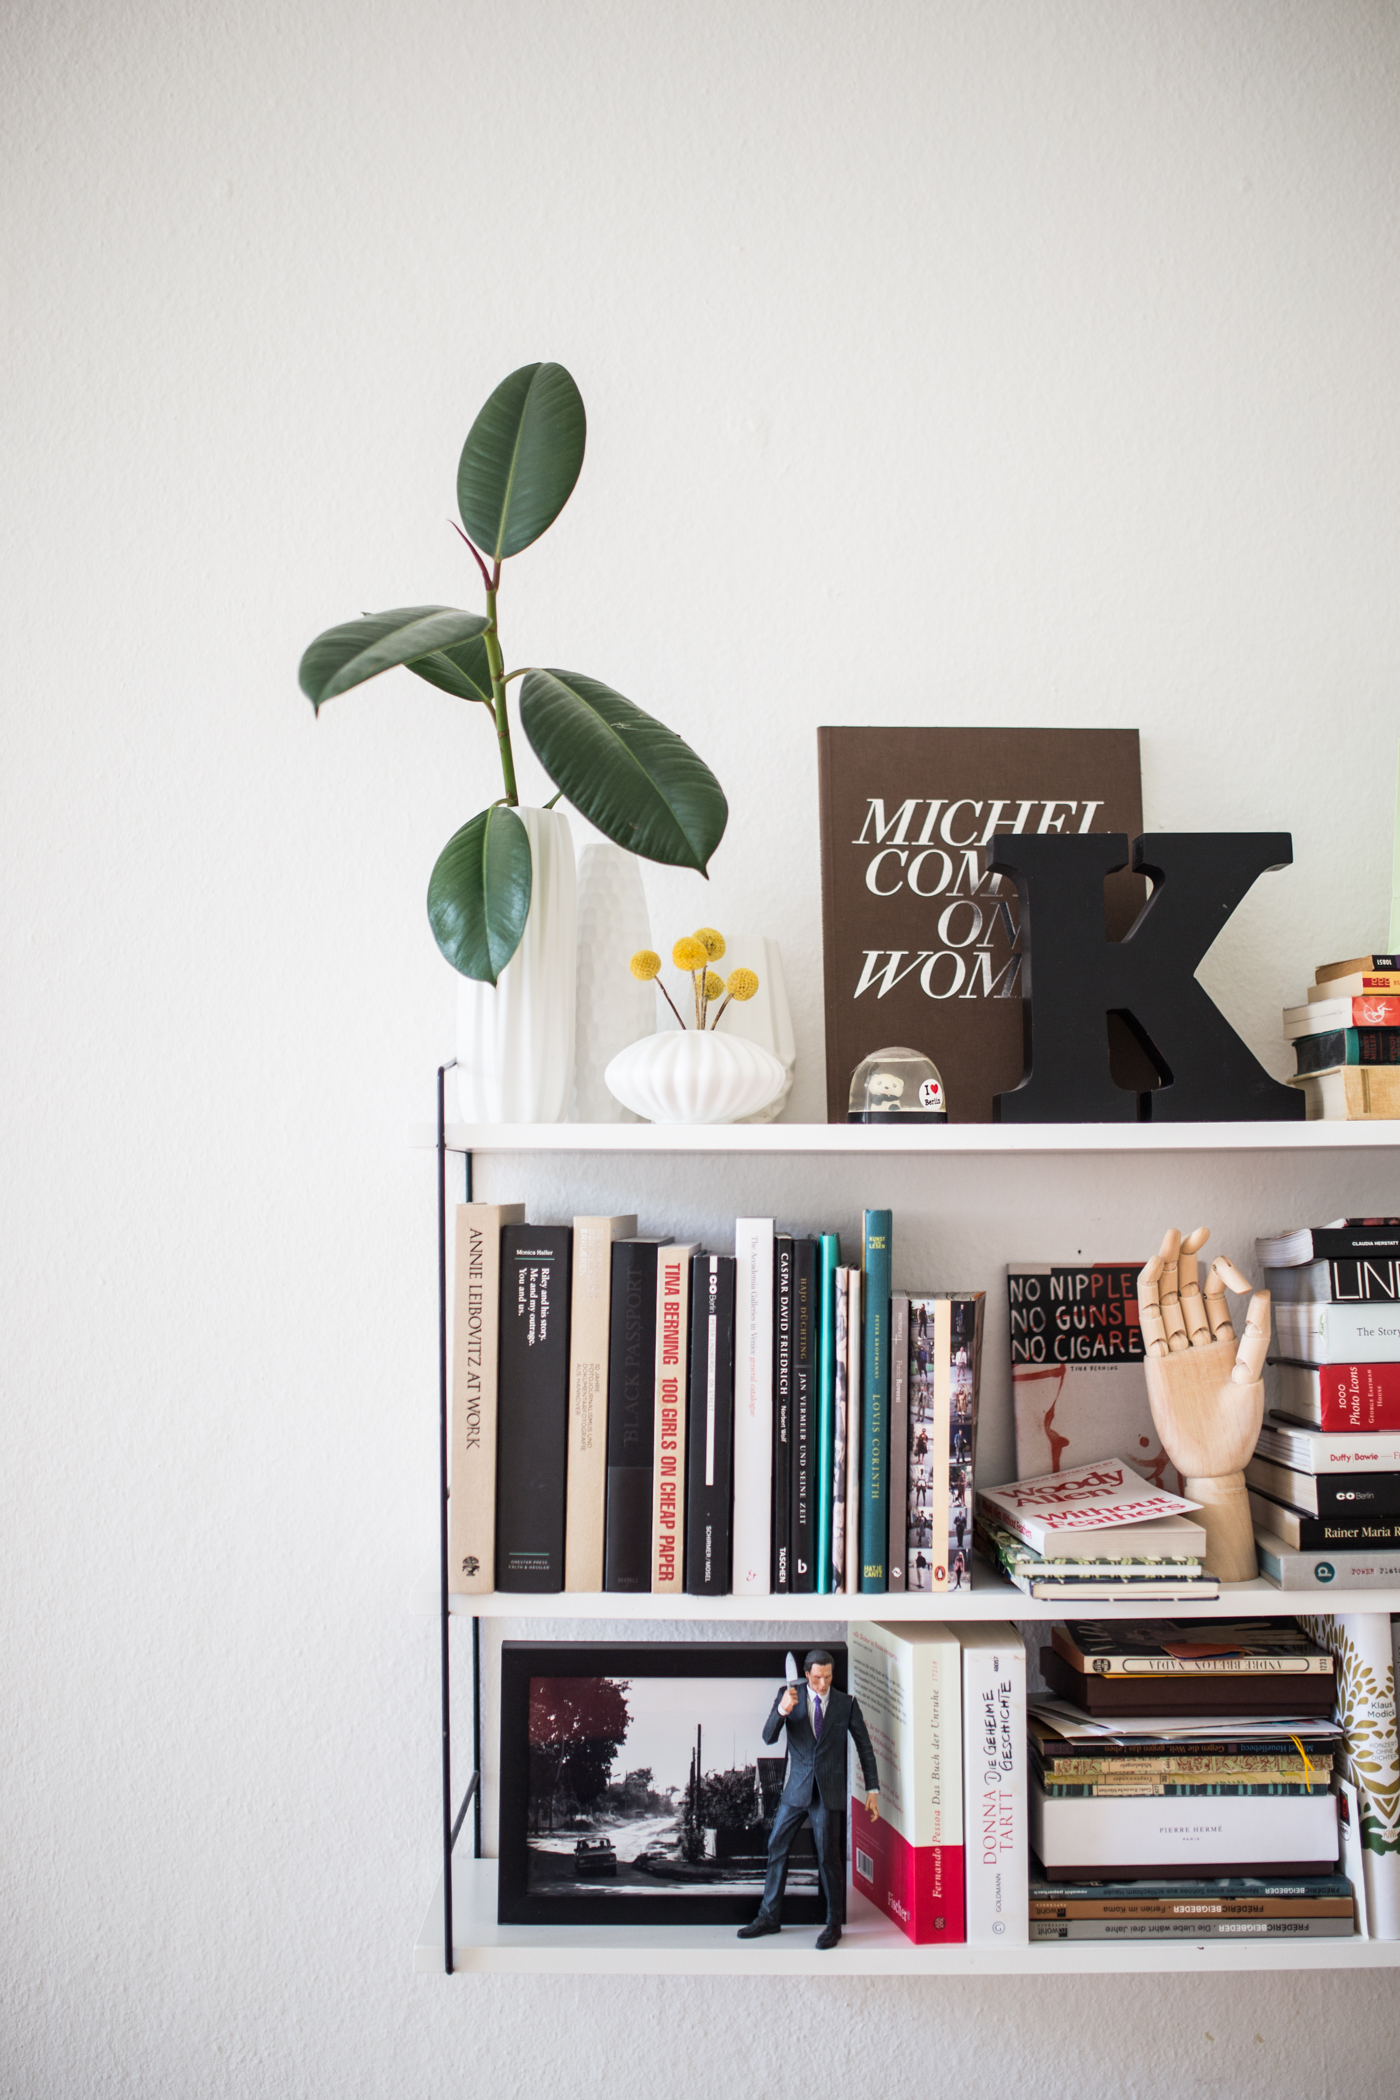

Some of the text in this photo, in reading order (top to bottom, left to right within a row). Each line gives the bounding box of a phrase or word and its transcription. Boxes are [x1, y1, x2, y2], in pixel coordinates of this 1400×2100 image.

[864, 849, 1022, 897] COM
[518, 1267, 527, 1284] You
[1010, 1273, 1134, 1303] NO NIPPLE
[1333, 1261, 1400, 1299] LIN
[518, 1286, 527, 1302] and
[527, 1267, 538, 1346] Me and my outrage.
[538, 1267, 550, 1341] Riley and his story.
[709, 1294, 717, 1314] Berlin
[748, 1236, 759, 1417] The Accademia Galleries in Venice general catalogue
[799, 1277, 809, 1360] HAJO DÜCHTING
[1011, 1302, 1123, 1334] NO GUNS
[1356, 1327, 1375, 1336] The
[466, 1228, 483, 1450] ANNIE LEIBOVITZ AT WORK
[779, 1253, 790, 1442] CASPAR DAVID FRIEDRICH Norbert Wolf
[1011, 1328, 1142, 1362] NO CIGARE
[623, 1265, 642, 1447] BLACK PASSPORT
[593, 1363, 601, 1393] 10 JAHRE
[580, 1363, 588, 1451] DOKUMENTARFOTOGRAFIE
[1338, 1384, 1347, 1409] 1000
[1349, 1366, 1360, 1425] Photo Icons
[658, 1262, 681, 1581] TINA BERNING 100 GIRLS ON CHEAP PAPER
[798, 1372, 807, 1525] JAN VERMEER UND SEINE ZEIT
[871, 1394, 881, 1499] LOVIS CORINTH
[1330, 1453, 1378, 1463] Duffy Bowie
[995, 1469, 1123, 1499] Woody
[1015, 1487, 1117, 1508] Allen
[1355, 1491, 1374, 1500] Berlin
[1033, 1496, 1173, 1522] Without
[1043, 1501, 1186, 1529] Feathers
[1324, 1526, 1391, 1539] Rainer Maria
[779, 1547, 787, 1583] TASCHEN
[1148, 1660, 1241, 1670] BRETON NADJA
[1371, 1701, 1393, 1709] Klaus
[982, 1689, 997, 1756] GEHEIME
[997, 1679, 1013, 1772] GESCHICHTE
[1104, 1743, 1286, 1753] Houellebecq Gegen die gegen das Leben
[1369, 1740, 1397, 1748] KONZERT
[930, 1689, 942, 1898] Fernando Pessoa Das Buch der Unruhe
[982, 1790, 997, 1865] DONNA
[998, 1790, 1014, 1853] TARTT
[1193, 1825, 1222, 1833] HERMÉ
[1180, 1887, 1205, 1895] Sohnes
[1103, 1906, 1166, 1914] Ferien im Koma
[1105, 1926, 1128, 1934] Jahre
[1130, 1926, 1146, 1934] drei
[1148, 1926, 1171, 1934] währt
[1173, 1925, 1195, 1933] Liebe
